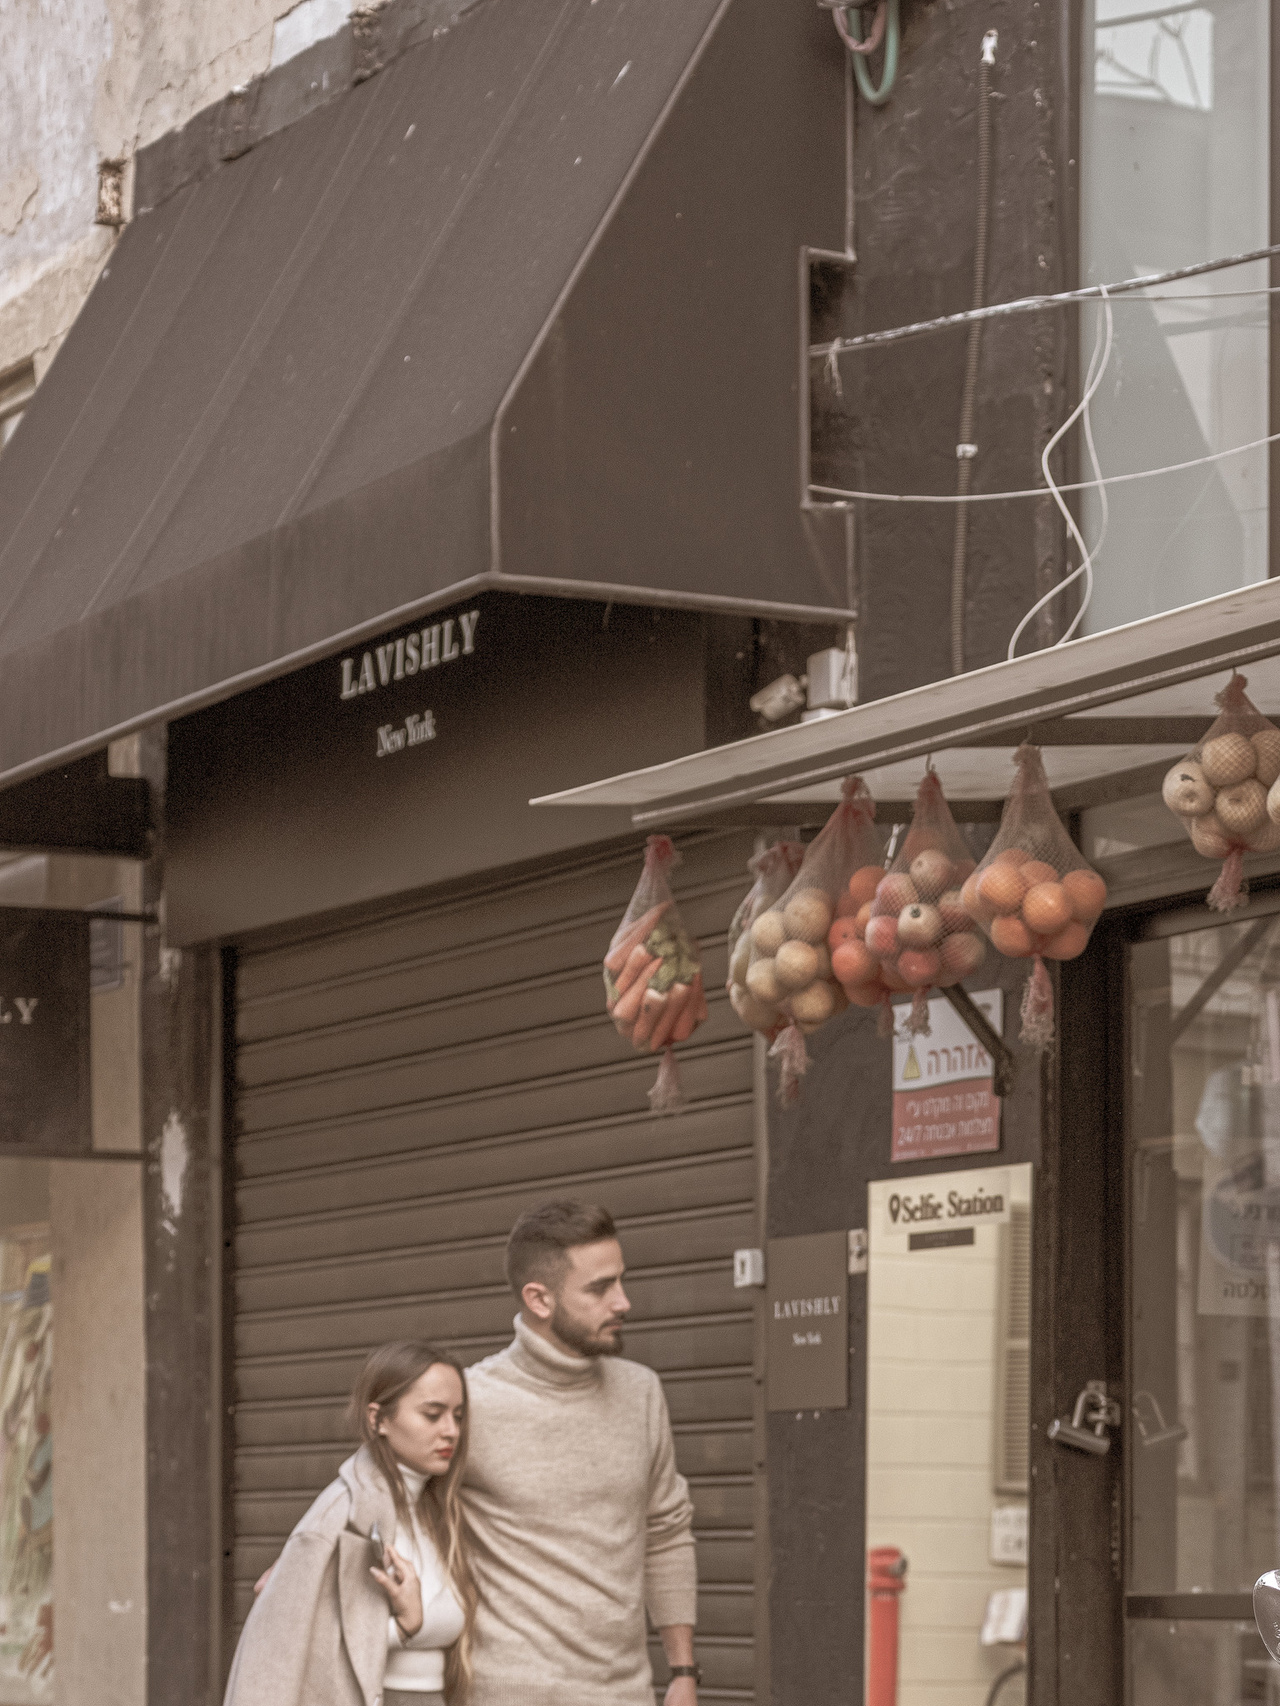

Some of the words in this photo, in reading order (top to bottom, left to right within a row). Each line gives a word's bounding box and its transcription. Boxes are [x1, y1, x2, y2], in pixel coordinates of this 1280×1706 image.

[340, 610, 480, 700] LAVISHLY
[376, 723, 407, 758] New
[405, 709, 437, 747] York
[927, 1043, 990, 1076] אזהרה
[901, 1192, 943, 1223] Selfie
[947, 1187, 1004, 1218] Station
